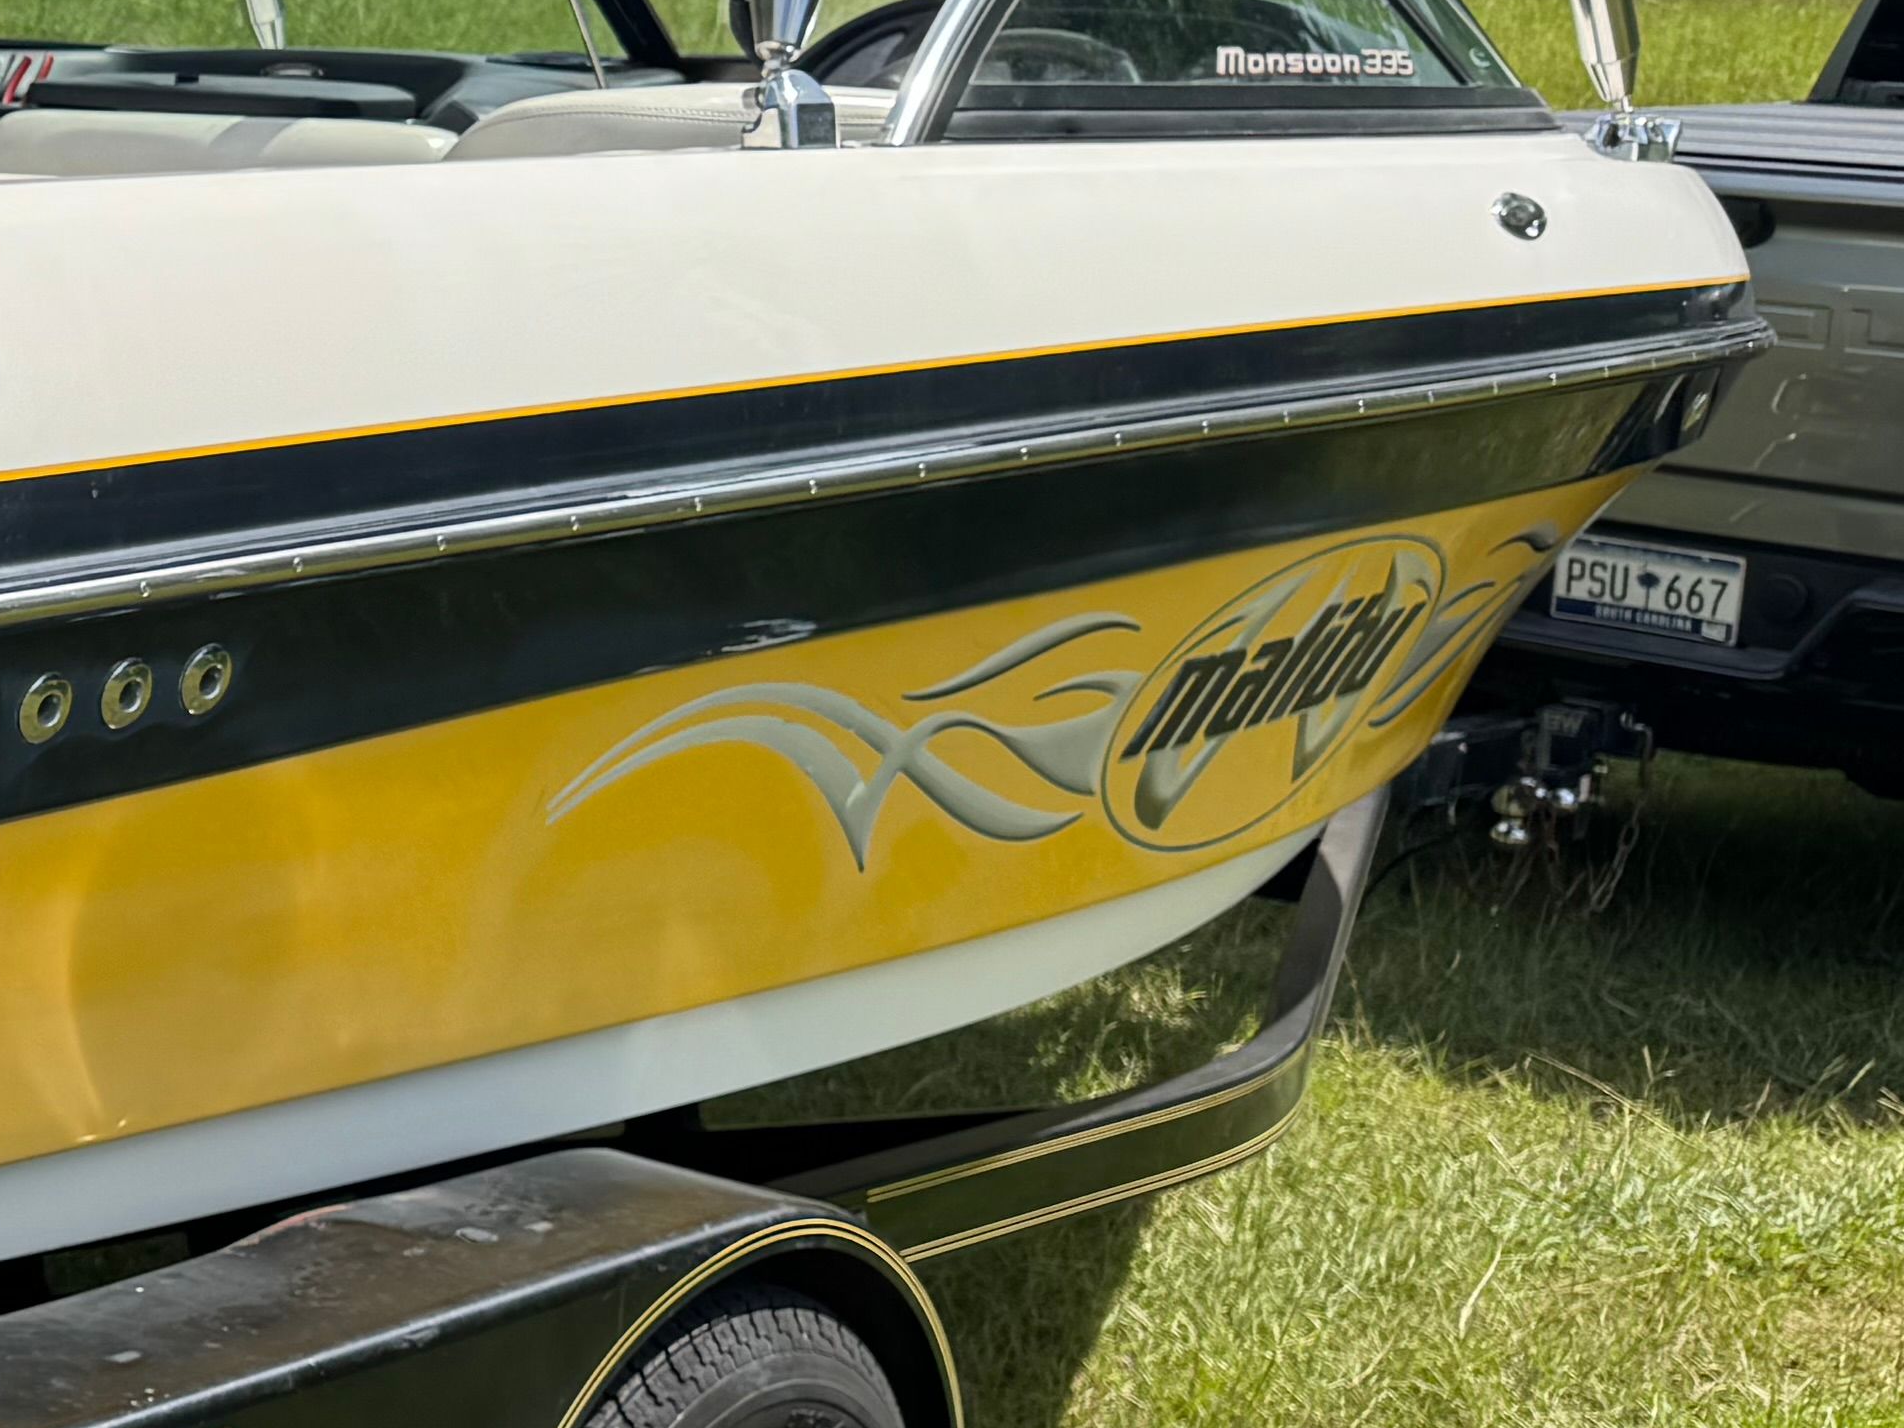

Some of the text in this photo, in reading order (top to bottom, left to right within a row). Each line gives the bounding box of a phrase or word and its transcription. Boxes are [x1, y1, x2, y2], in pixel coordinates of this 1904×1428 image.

[1216, 45, 1415, 76] Monsoon 335
[1565, 557, 1728, 618] PSU 667
[1119, 592, 1428, 763] malibu
